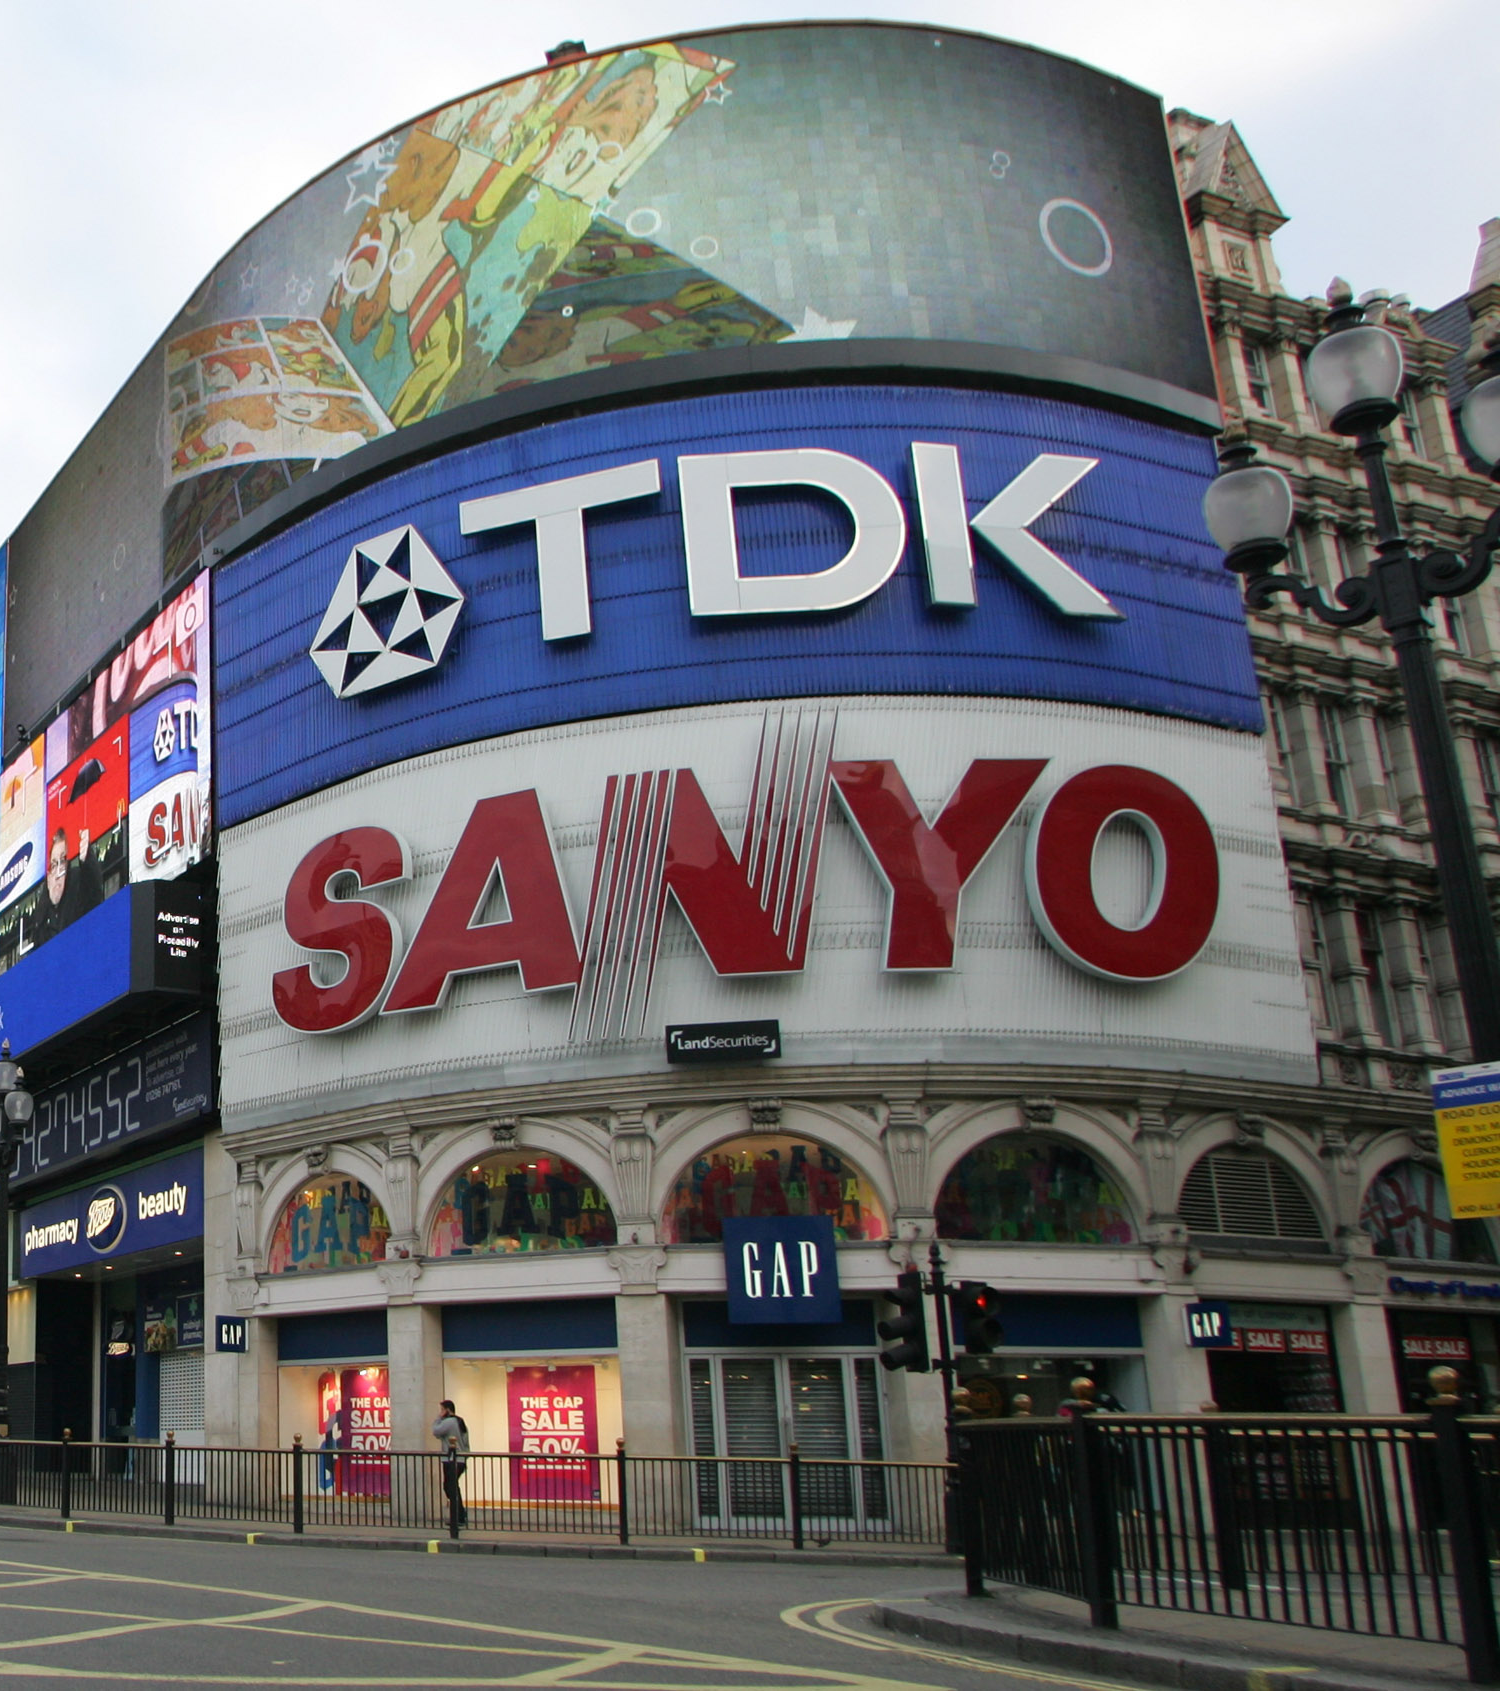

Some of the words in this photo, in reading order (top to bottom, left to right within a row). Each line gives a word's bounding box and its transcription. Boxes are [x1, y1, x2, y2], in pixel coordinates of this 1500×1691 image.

[459, 441, 1124, 642] TDK
[271, 706, 1221, 1041] SANYO
[170, 947, 187, 957] Lite
[677, 1034, 769, 1051] LandSecurities
[1440, 1085, 1486, 1098] ADVANCE
[8, 1056, 142, 1179] 4,274,552
[1442, 1107, 1475, 1120] ROAD
[25, 1218, 79, 1256] pharmacy
[86, 1197, 116, 1239] Boots
[139, 1182, 188, 1220] beauty
[742, 1240, 818, 1298] GAP
[222, 1324, 242, 1345] GAP
[1191, 1311, 1222, 1338] GAP
[1247, 1331, 1282, 1348] SALE
[1290, 1333, 1325, 1349] SALE
[1402, 1339, 1432, 1353] SALE
[1435, 1340, 1466, 1354] SALE
[350, 1397, 371, 1409] THE
[520, 1397, 548, 1409] THE
[553, 1396, 583, 1409] GAP
[521, 1410, 584, 1431] SALE
[522, 1437, 586, 1463] 50%
